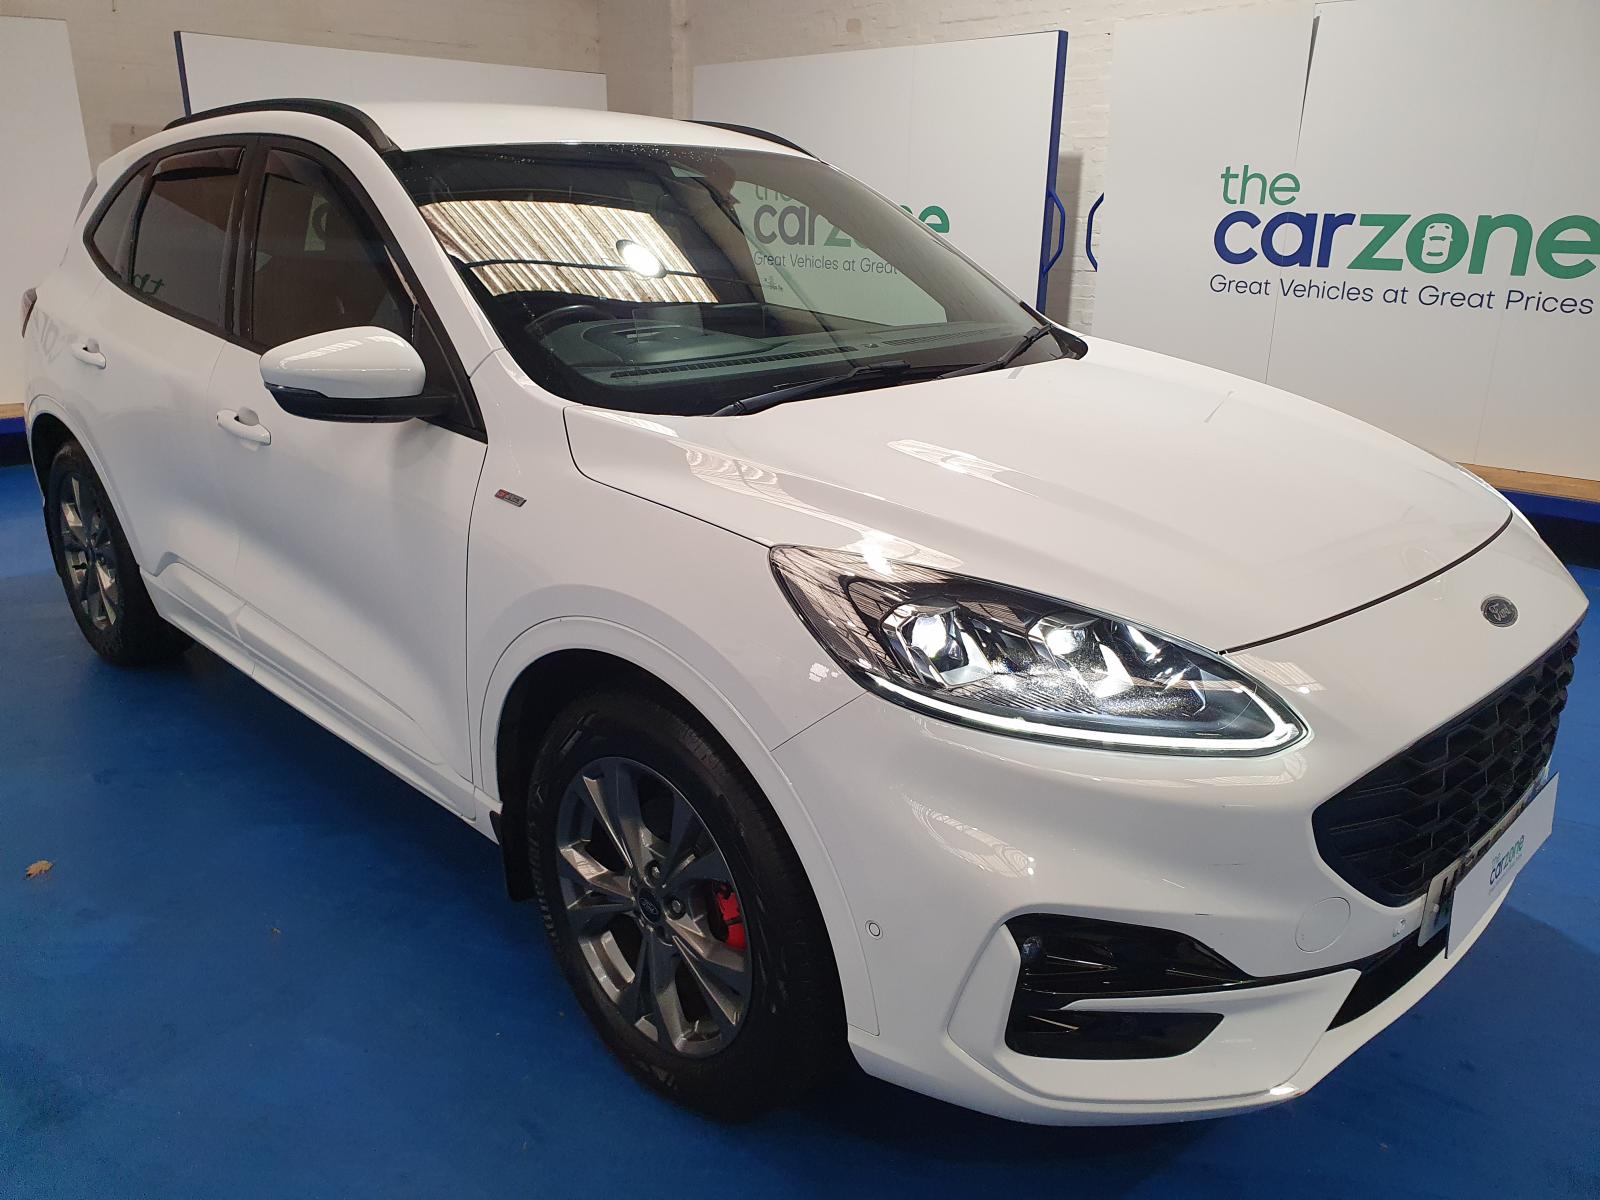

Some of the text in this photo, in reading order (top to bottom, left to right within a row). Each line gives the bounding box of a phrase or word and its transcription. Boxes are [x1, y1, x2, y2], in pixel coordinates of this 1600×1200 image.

[1221, 164, 1301, 206] the
[753, 252, 786, 266] Great
[789, 253, 839, 271] Vehicles
[843, 255, 856, 272] at
[1213, 210, 1600, 280] carzone
[1209, 274, 1594, 315] Great Vehicles at Great Prices
